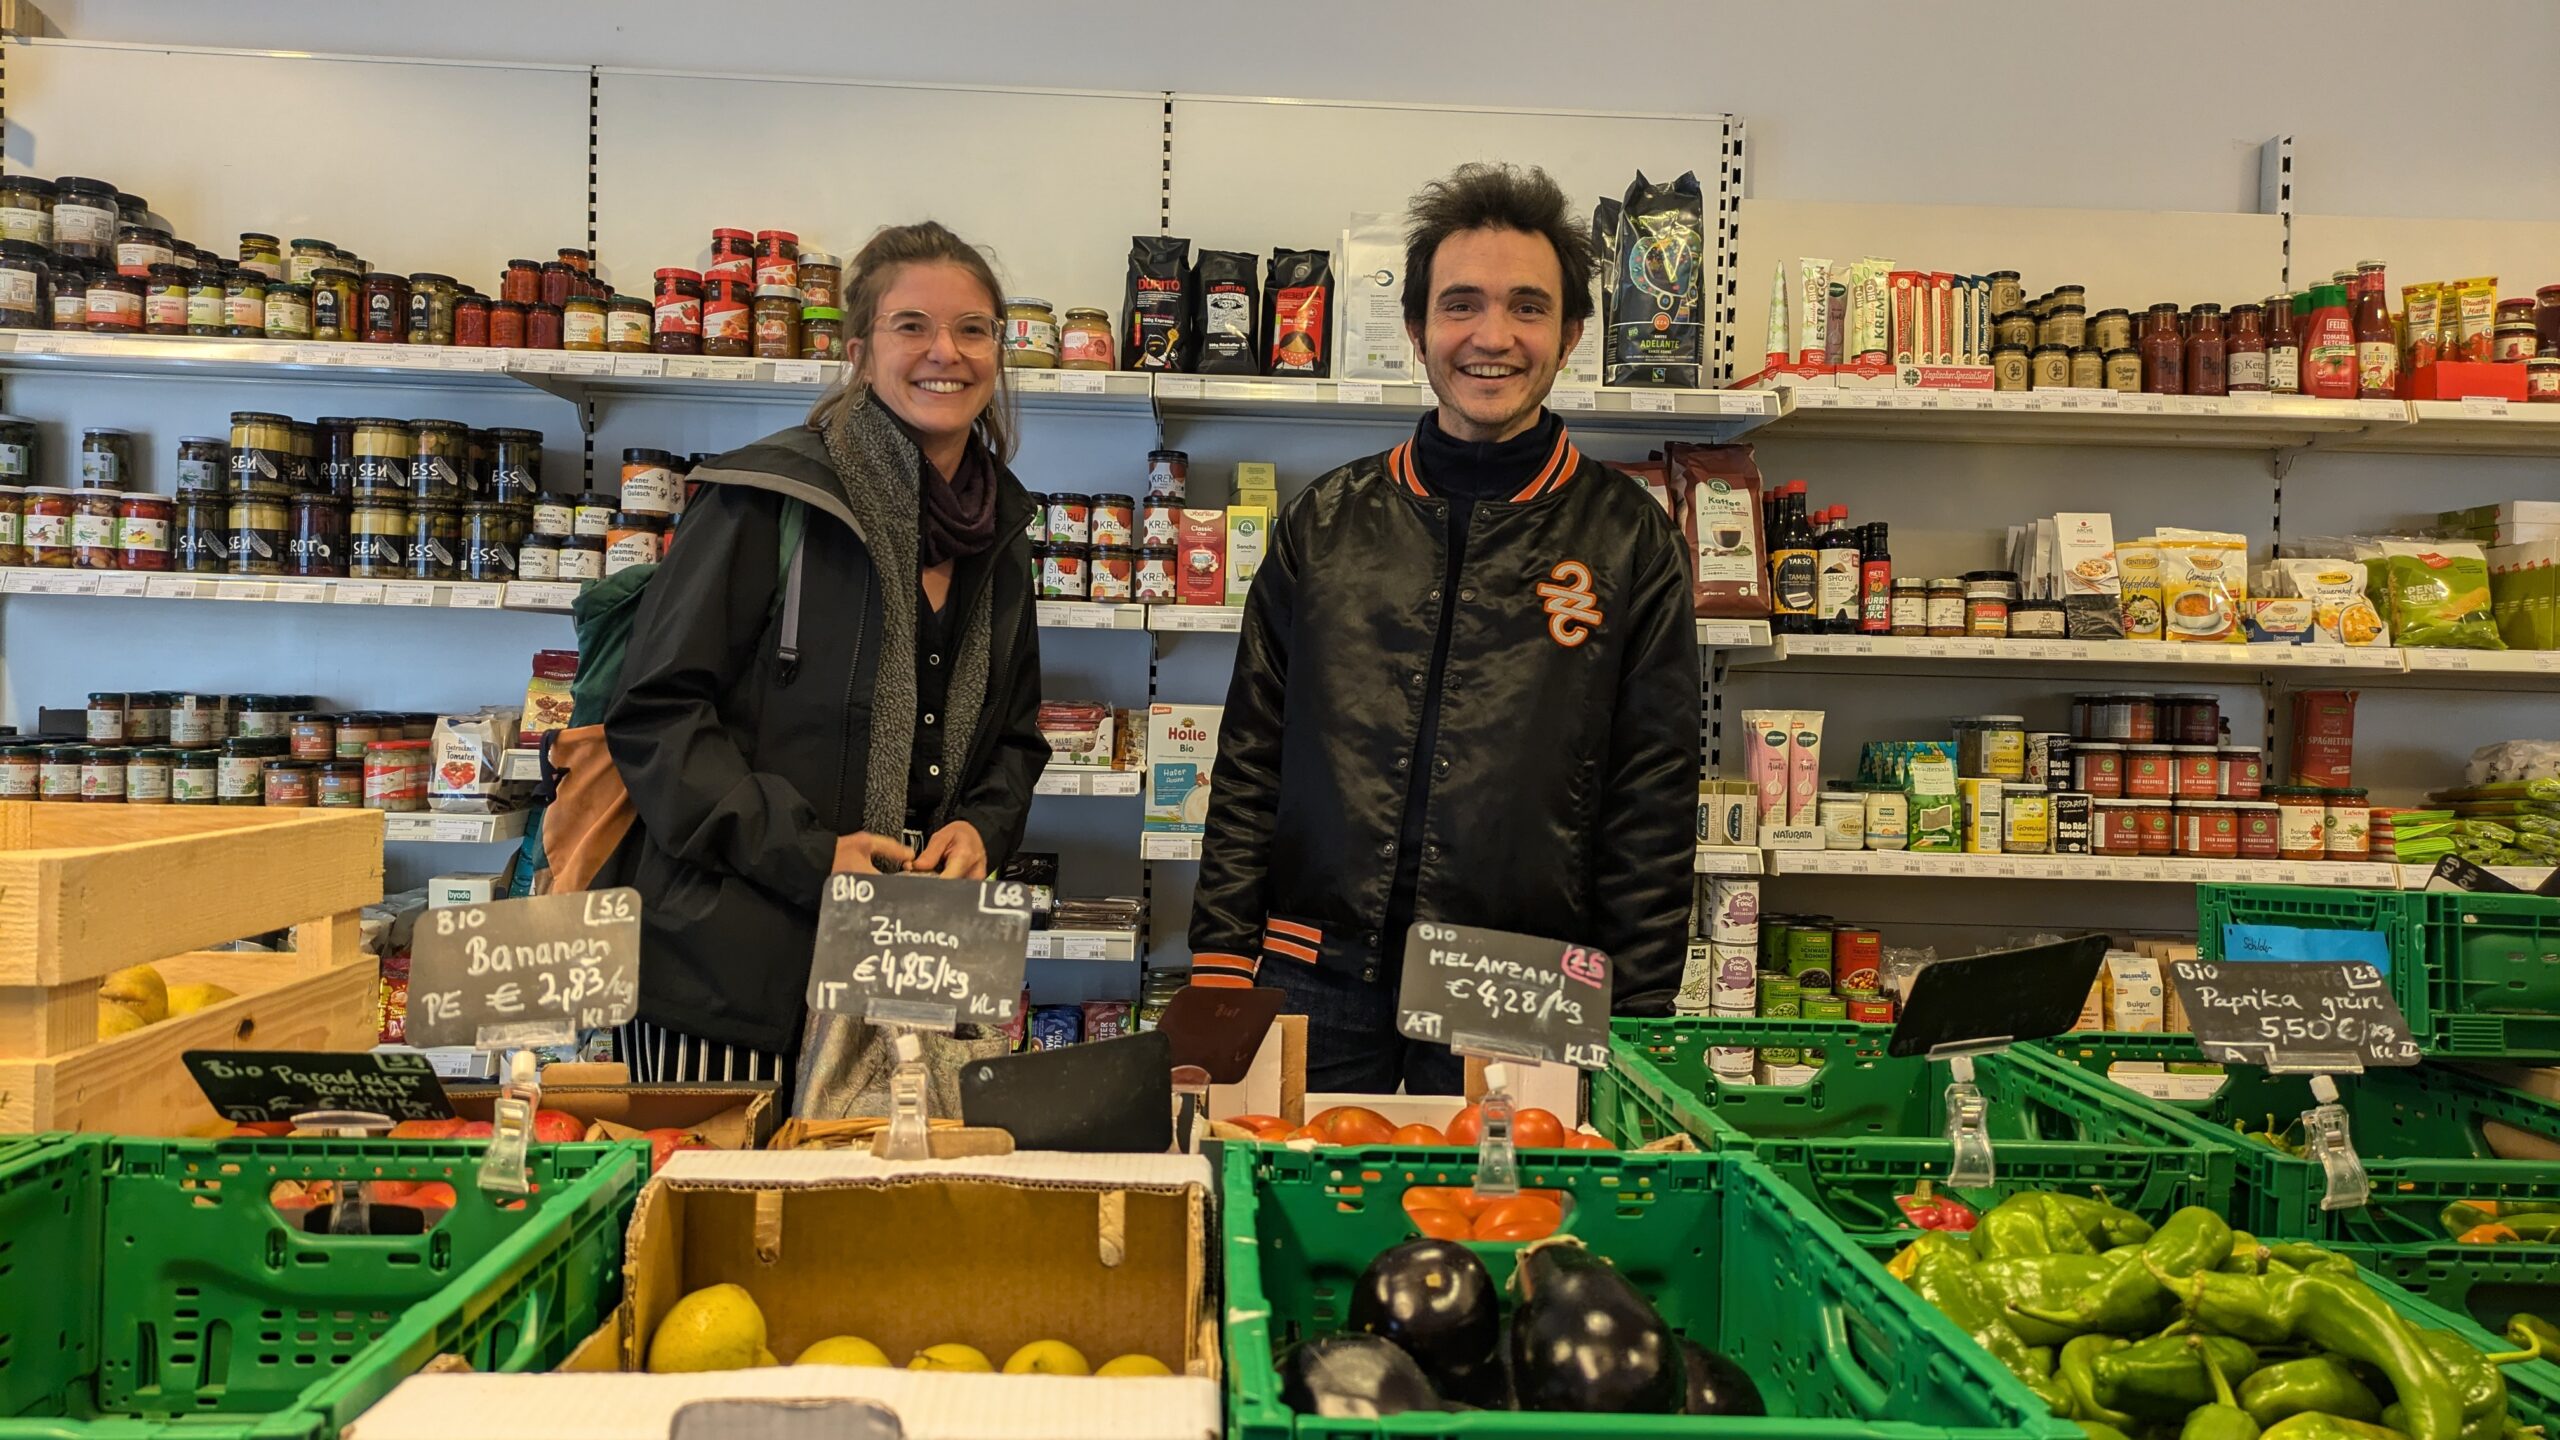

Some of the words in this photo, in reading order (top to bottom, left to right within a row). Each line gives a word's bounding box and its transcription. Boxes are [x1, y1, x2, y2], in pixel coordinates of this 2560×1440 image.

[1816, 265, 1826, 341] ESTRAGON
[1875, 271, 1885, 340] KREMSR
[1640, 339, 1680, 349] ADELANTE
[412, 462, 439, 476] ESS
[491, 469, 520, 485] ESS
[1708, 496, 1741, 507] Kaffee
[1055, 523, 1074, 533] RAK
[1149, 520, 1174, 530] KREM
[179, 535, 207, 549] SAL
[290, 539, 318, 553] ROT
[408, 544, 433, 558] ESS
[470, 547, 500, 562] ESS
[1788, 558, 1811, 566] YAKSO
[1046, 576, 1065, 586] RAK
[1143, 572, 1169, 581] KREM
[1788, 573, 1812, 581] TAMARI
[1168, 726, 1207, 742] Holle
[1179, 744, 1194, 753] Bio
[446, 751, 475, 761] Tomaten
[1163, 768, 1187, 777] Hafer
[2059, 822, 2072, 830] Bio
[1773, 830, 1813, 840] NATURATA
[2060, 830, 2086, 839] zwiebel
[448, 889, 471, 900] byodo
[831, 874, 875, 904] BIO
[436, 908, 486, 935] BIO
[870, 916, 960, 949] Zitronen
[1418, 923, 1458, 943] BIO
[2243, 937, 2273, 953] Schilder
[465, 935, 612, 976] Bananen
[1429, 948, 1566, 990] MELANZANI
[816, 981, 849, 1010] IT
[421, 989, 462, 1027] PE
[2126, 1001, 2152, 1009] Bulgur
[2195, 986, 2304, 1016] Paprika
[2320, 991, 2384, 1021] grün
[202, 1058, 263, 1079] Bio
[271, 1065, 420, 1088] Paradeiser
